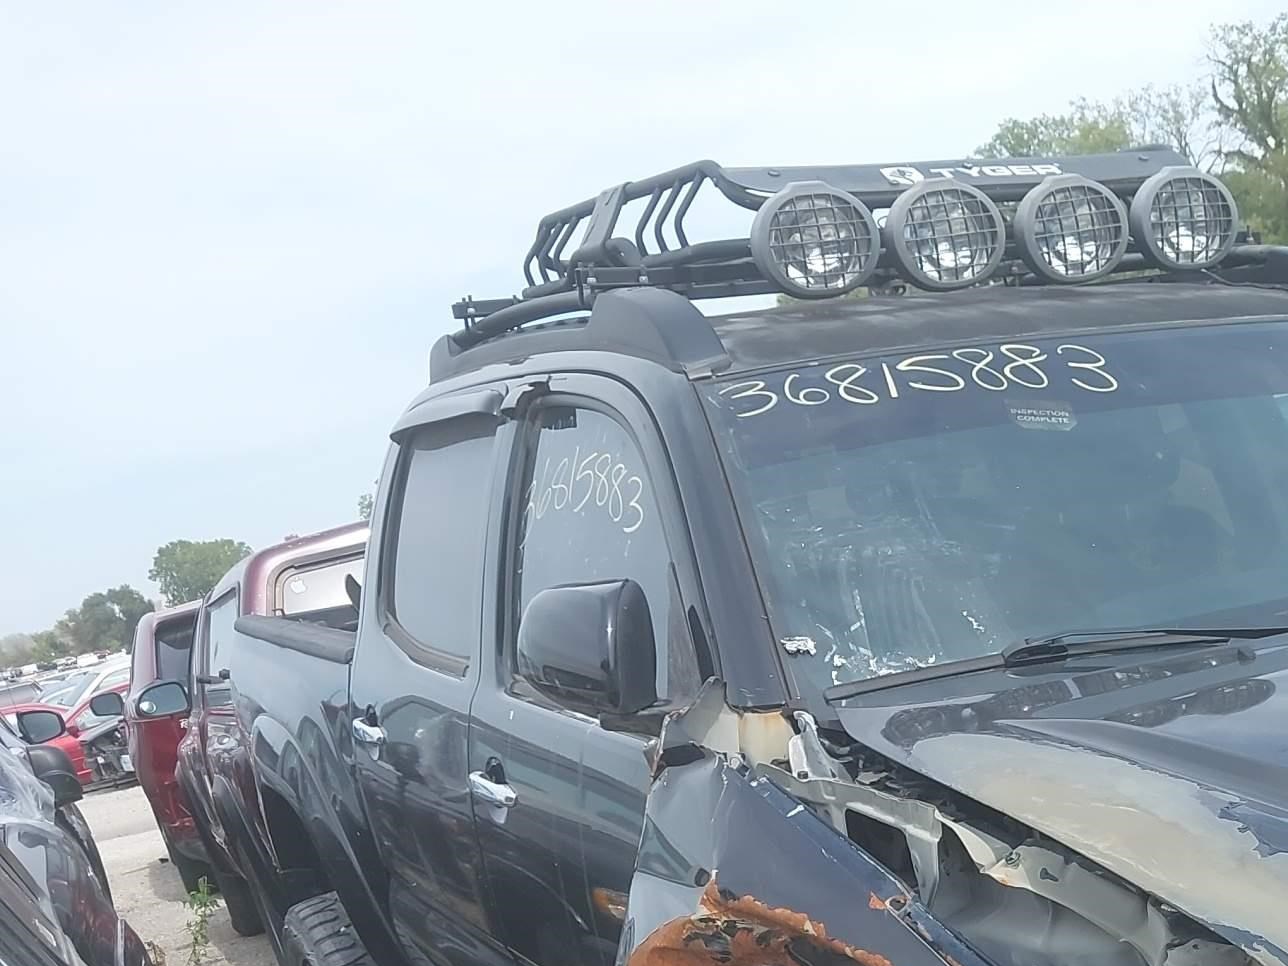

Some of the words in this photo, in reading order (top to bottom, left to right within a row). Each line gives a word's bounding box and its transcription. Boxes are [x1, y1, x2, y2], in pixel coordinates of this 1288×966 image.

[930, 163, 1063, 179] TYGER
[718, 344, 1118, 418] 36815883
[1016, 415, 1071, 424] COMPLETE
[520, 446, 644, 550] 36815883
